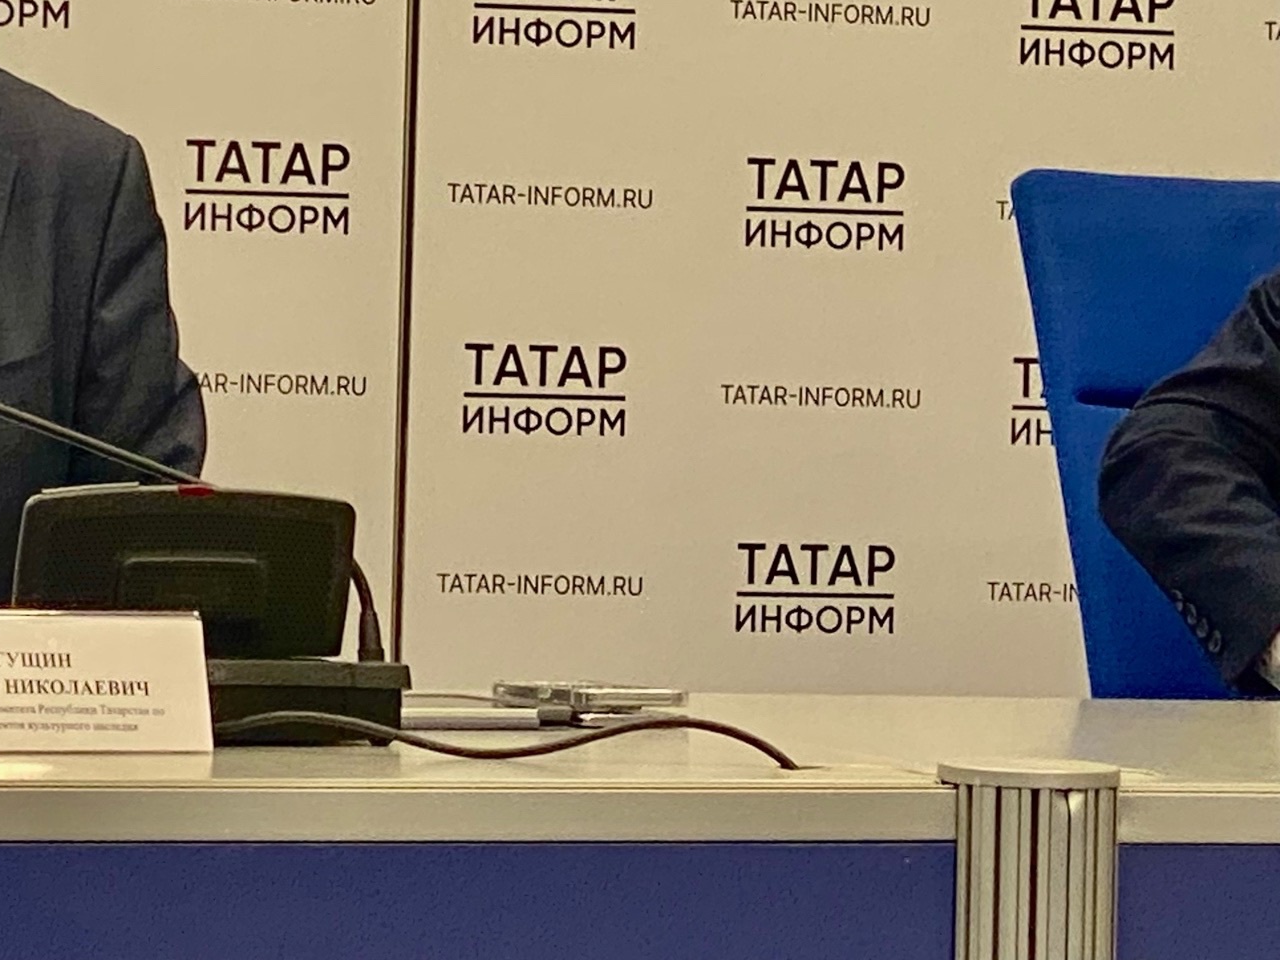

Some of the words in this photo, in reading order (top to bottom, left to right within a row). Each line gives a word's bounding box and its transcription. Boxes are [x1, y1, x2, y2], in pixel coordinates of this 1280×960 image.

[730, 0, 930, 27] TATAR-INFORM.RU
[472, 15, 636, 50] ИНФОРМ
[1020, 36, 1175, 71] ИНФОРМ
[185, 139, 351, 186] ТАТАР
[447, 182, 653, 210] TATAR-INFORM.RU
[747, 157, 905, 204] ТАТАР
[184, 201, 349, 236] ИНФОРМ
[745, 218, 904, 252] ИНФОРМ
[464, 342, 627, 389] ТАТАР
[1013, 357, 1045, 398] Т
[194, 372, 367, 396] AR-INFORM.RU
[720, 384, 921, 409] TATAR-INFORM.RU
[462, 404, 626, 437] ИНФОРМ
[737, 542, 896, 587] ТАТАР
[436, 573, 643, 597] TATAR-INFORM.RU
[735, 604, 895, 635] ИНФОРМ
[5, 678, 151, 697] НИКОЛАЕВИЧ
